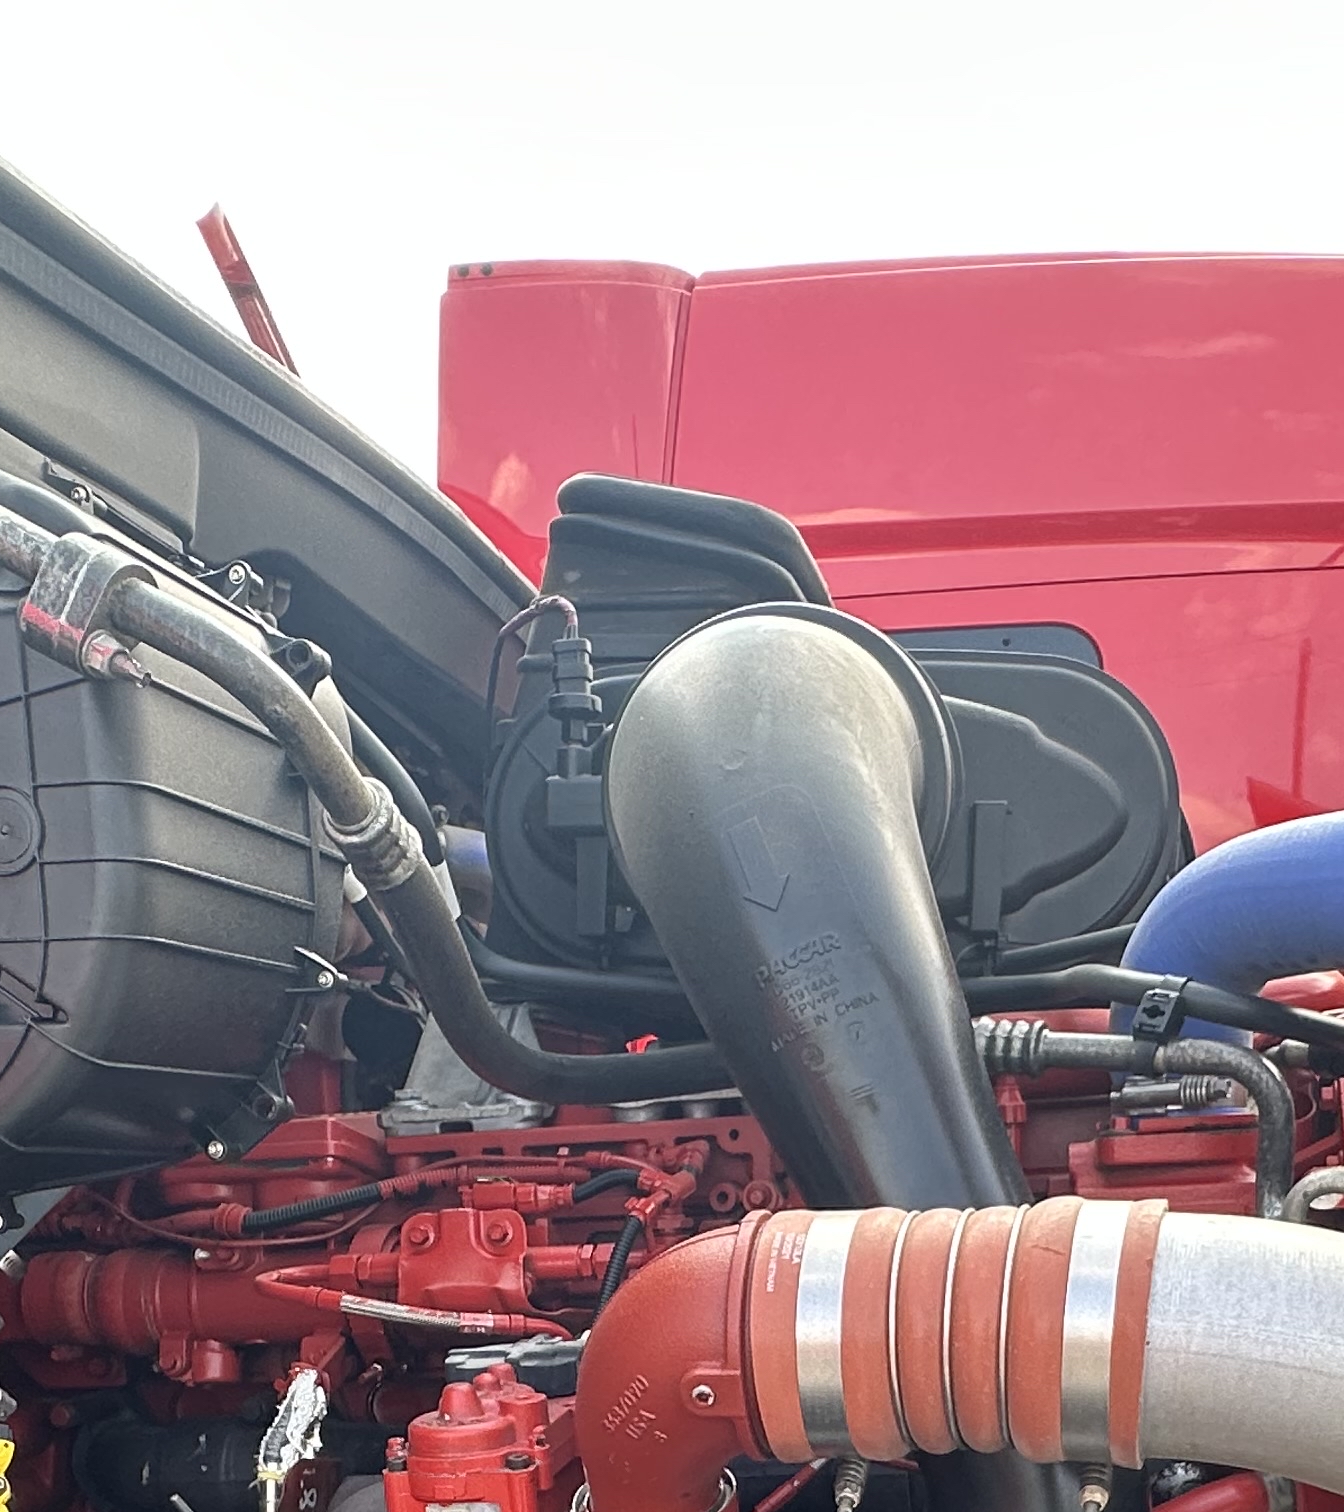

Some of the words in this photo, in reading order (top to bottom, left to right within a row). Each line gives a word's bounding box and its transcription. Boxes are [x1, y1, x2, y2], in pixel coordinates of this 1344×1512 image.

[756, 932, 841, 990] PACCAR
[814, 1012, 828, 1026] IN
[835, 992, 880, 1016] CHINA
[625, 1409, 656, 1439] USA
